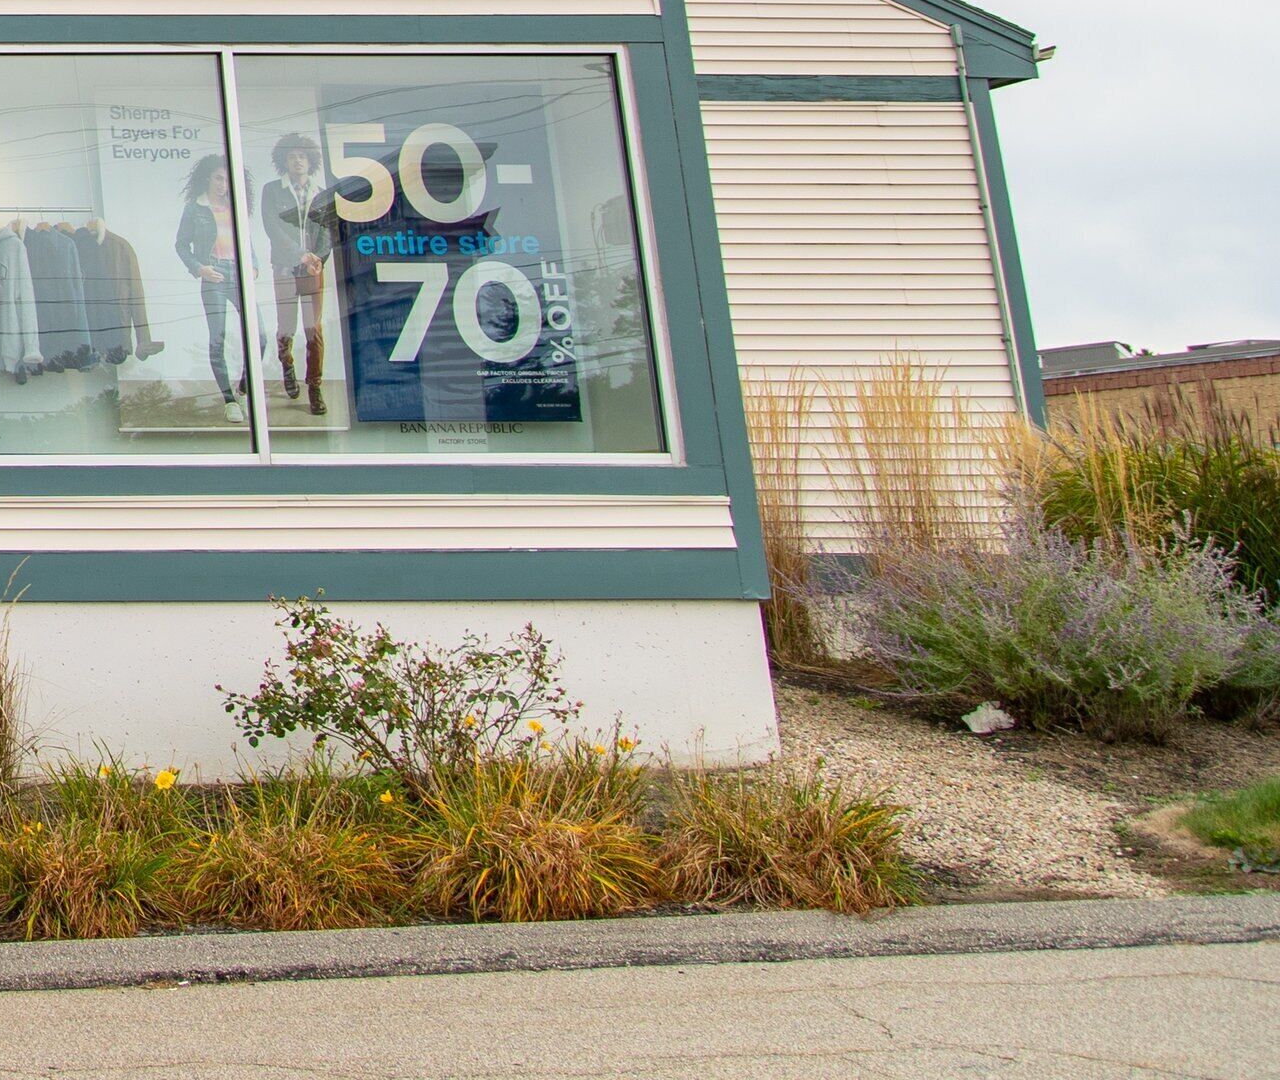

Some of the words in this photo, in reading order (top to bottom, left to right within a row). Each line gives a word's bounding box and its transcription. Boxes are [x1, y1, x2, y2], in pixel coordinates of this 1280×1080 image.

[110, 106, 171, 123] Sherpa
[110, 125, 167, 142] Layers
[172, 125, 200, 139] For
[112, 145, 191, 162] Everyone
[357, 230, 448, 256] entire
[459, 233, 540, 256] store
[375, 261, 541, 363] 70
[400, 422, 456, 434] BANANA
[459, 422, 523, 434] REPUBLIC
